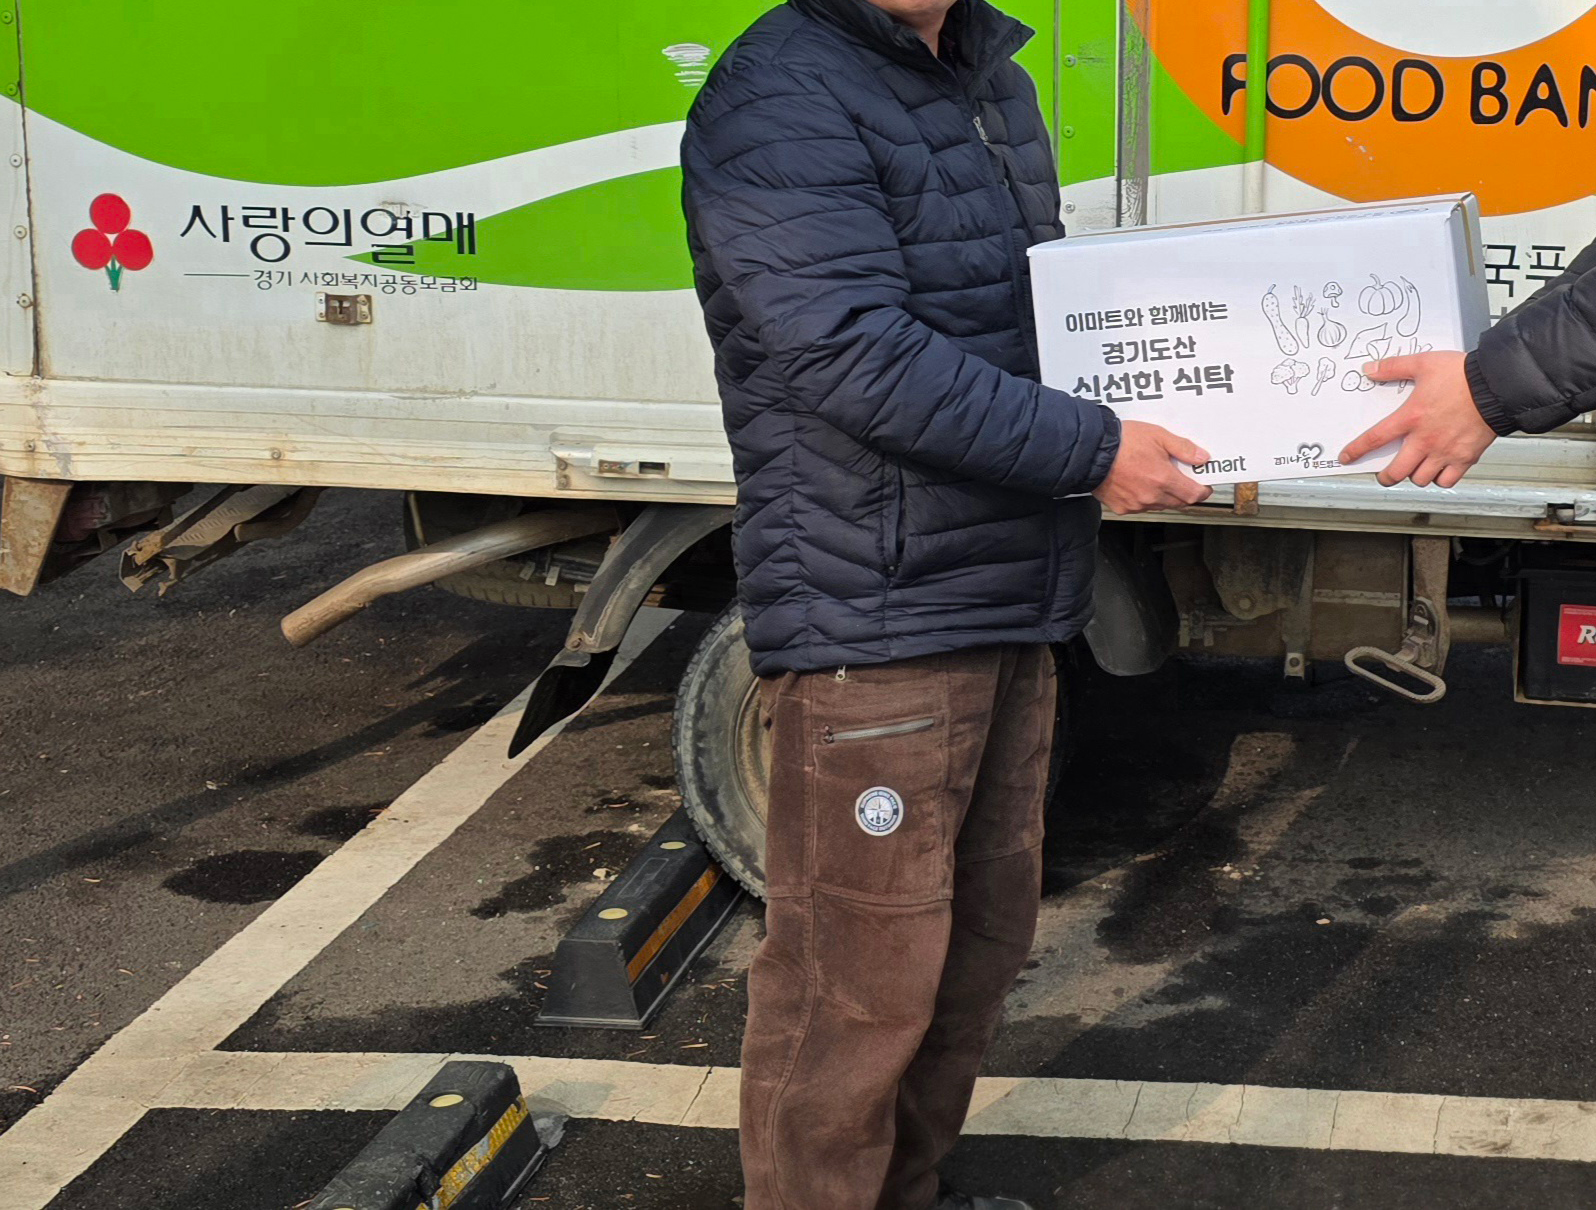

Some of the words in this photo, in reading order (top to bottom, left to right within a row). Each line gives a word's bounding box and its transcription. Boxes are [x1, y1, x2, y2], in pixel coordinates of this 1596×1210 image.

[1222, 53, 1445, 122] FOOD
[253, 269, 292, 291] 경기
[299, 271, 478, 295] 사회복지공동모금회
[1065, 307, 1145, 333] 이마트와
[1148, 301, 1228, 326] 함께하는
[1101, 335, 1197, 366] 경기도산
[1072, 368, 1164, 405] 신선한
[1172, 363, 1235, 396] 식탁
[1192, 455, 1247, 475] emart
